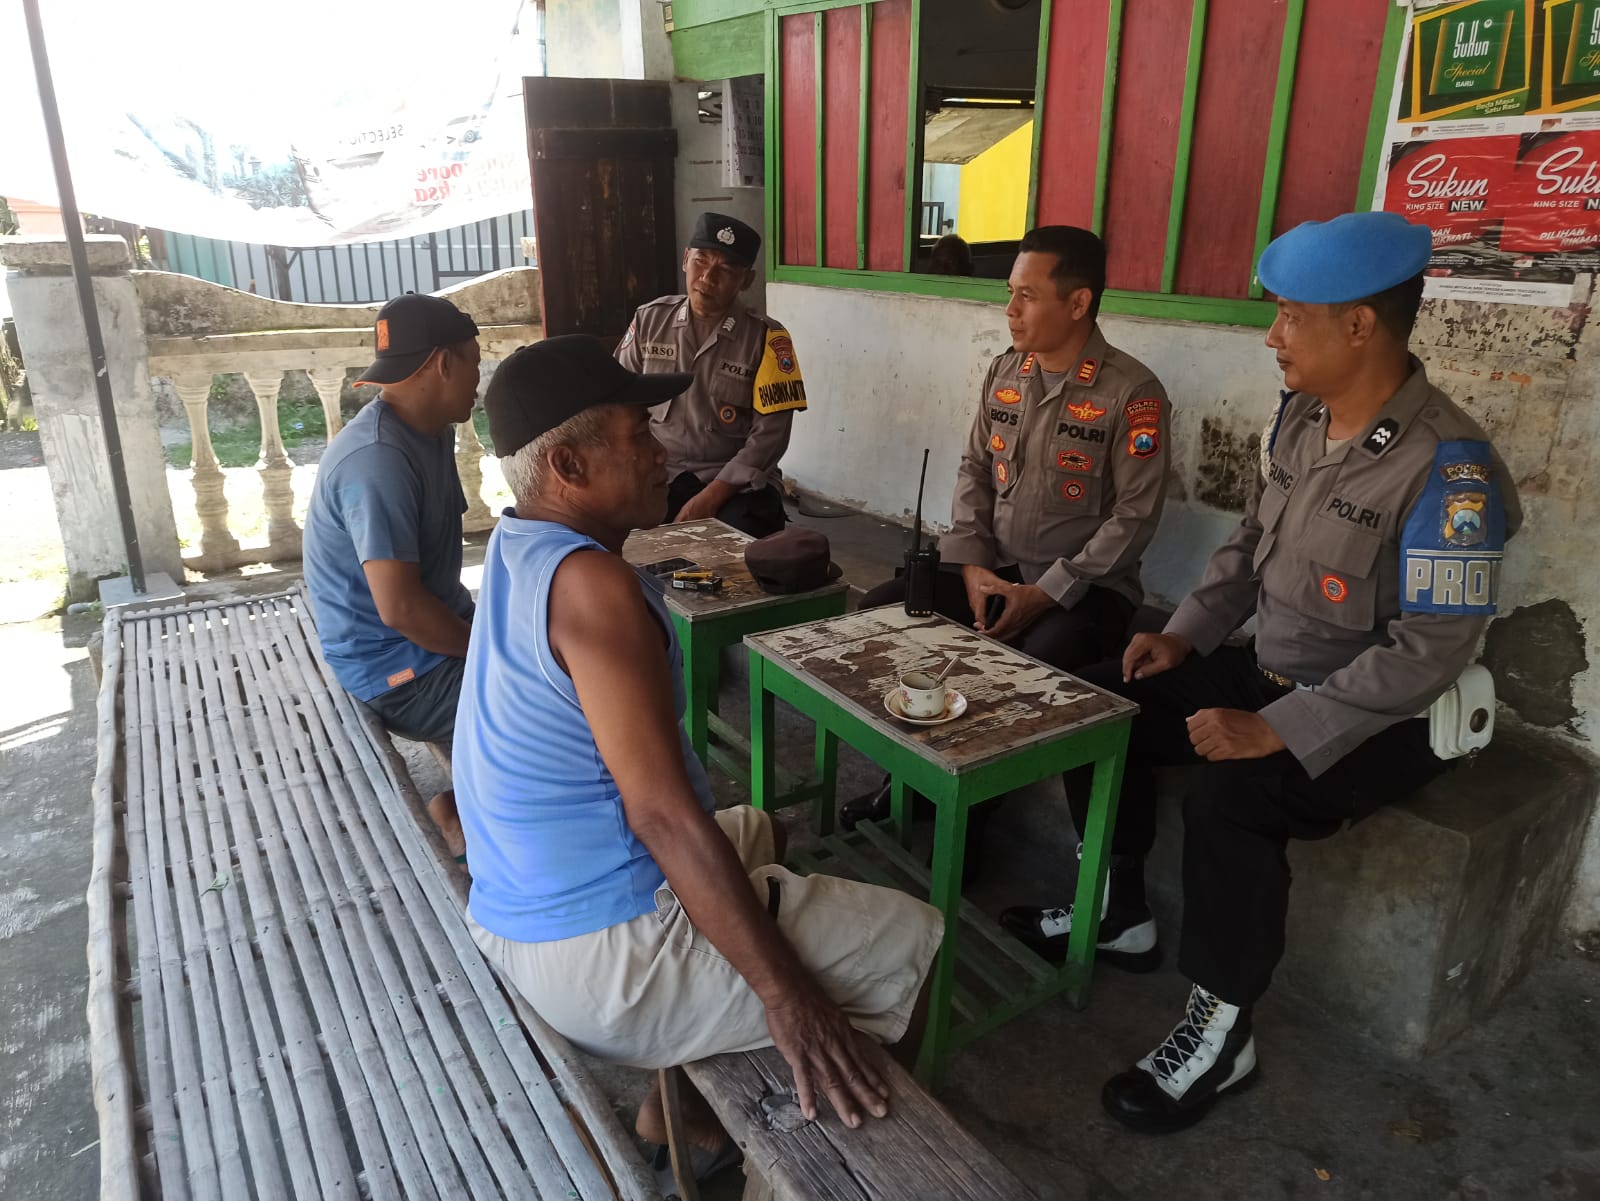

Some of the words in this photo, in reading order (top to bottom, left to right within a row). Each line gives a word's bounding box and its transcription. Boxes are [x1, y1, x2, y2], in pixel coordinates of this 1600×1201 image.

[1406, 153, 1489, 198] Sukun
[1405, 203, 1425, 211] KING
[1426, 202, 1445, 210] SIZE
[1450, 200, 1485, 212] NEW
[1533, 201, 1557, 209] KING
[1558, 200, 1580, 208] SIZE
[1538, 227, 1587, 241] PILIHAN
[1560, 234, 1600, 247] NIKMA
[1057, 422, 1106, 444] POLRI
[1327, 498, 1381, 529] POLRI
[1406, 557, 1498, 606] PRO
